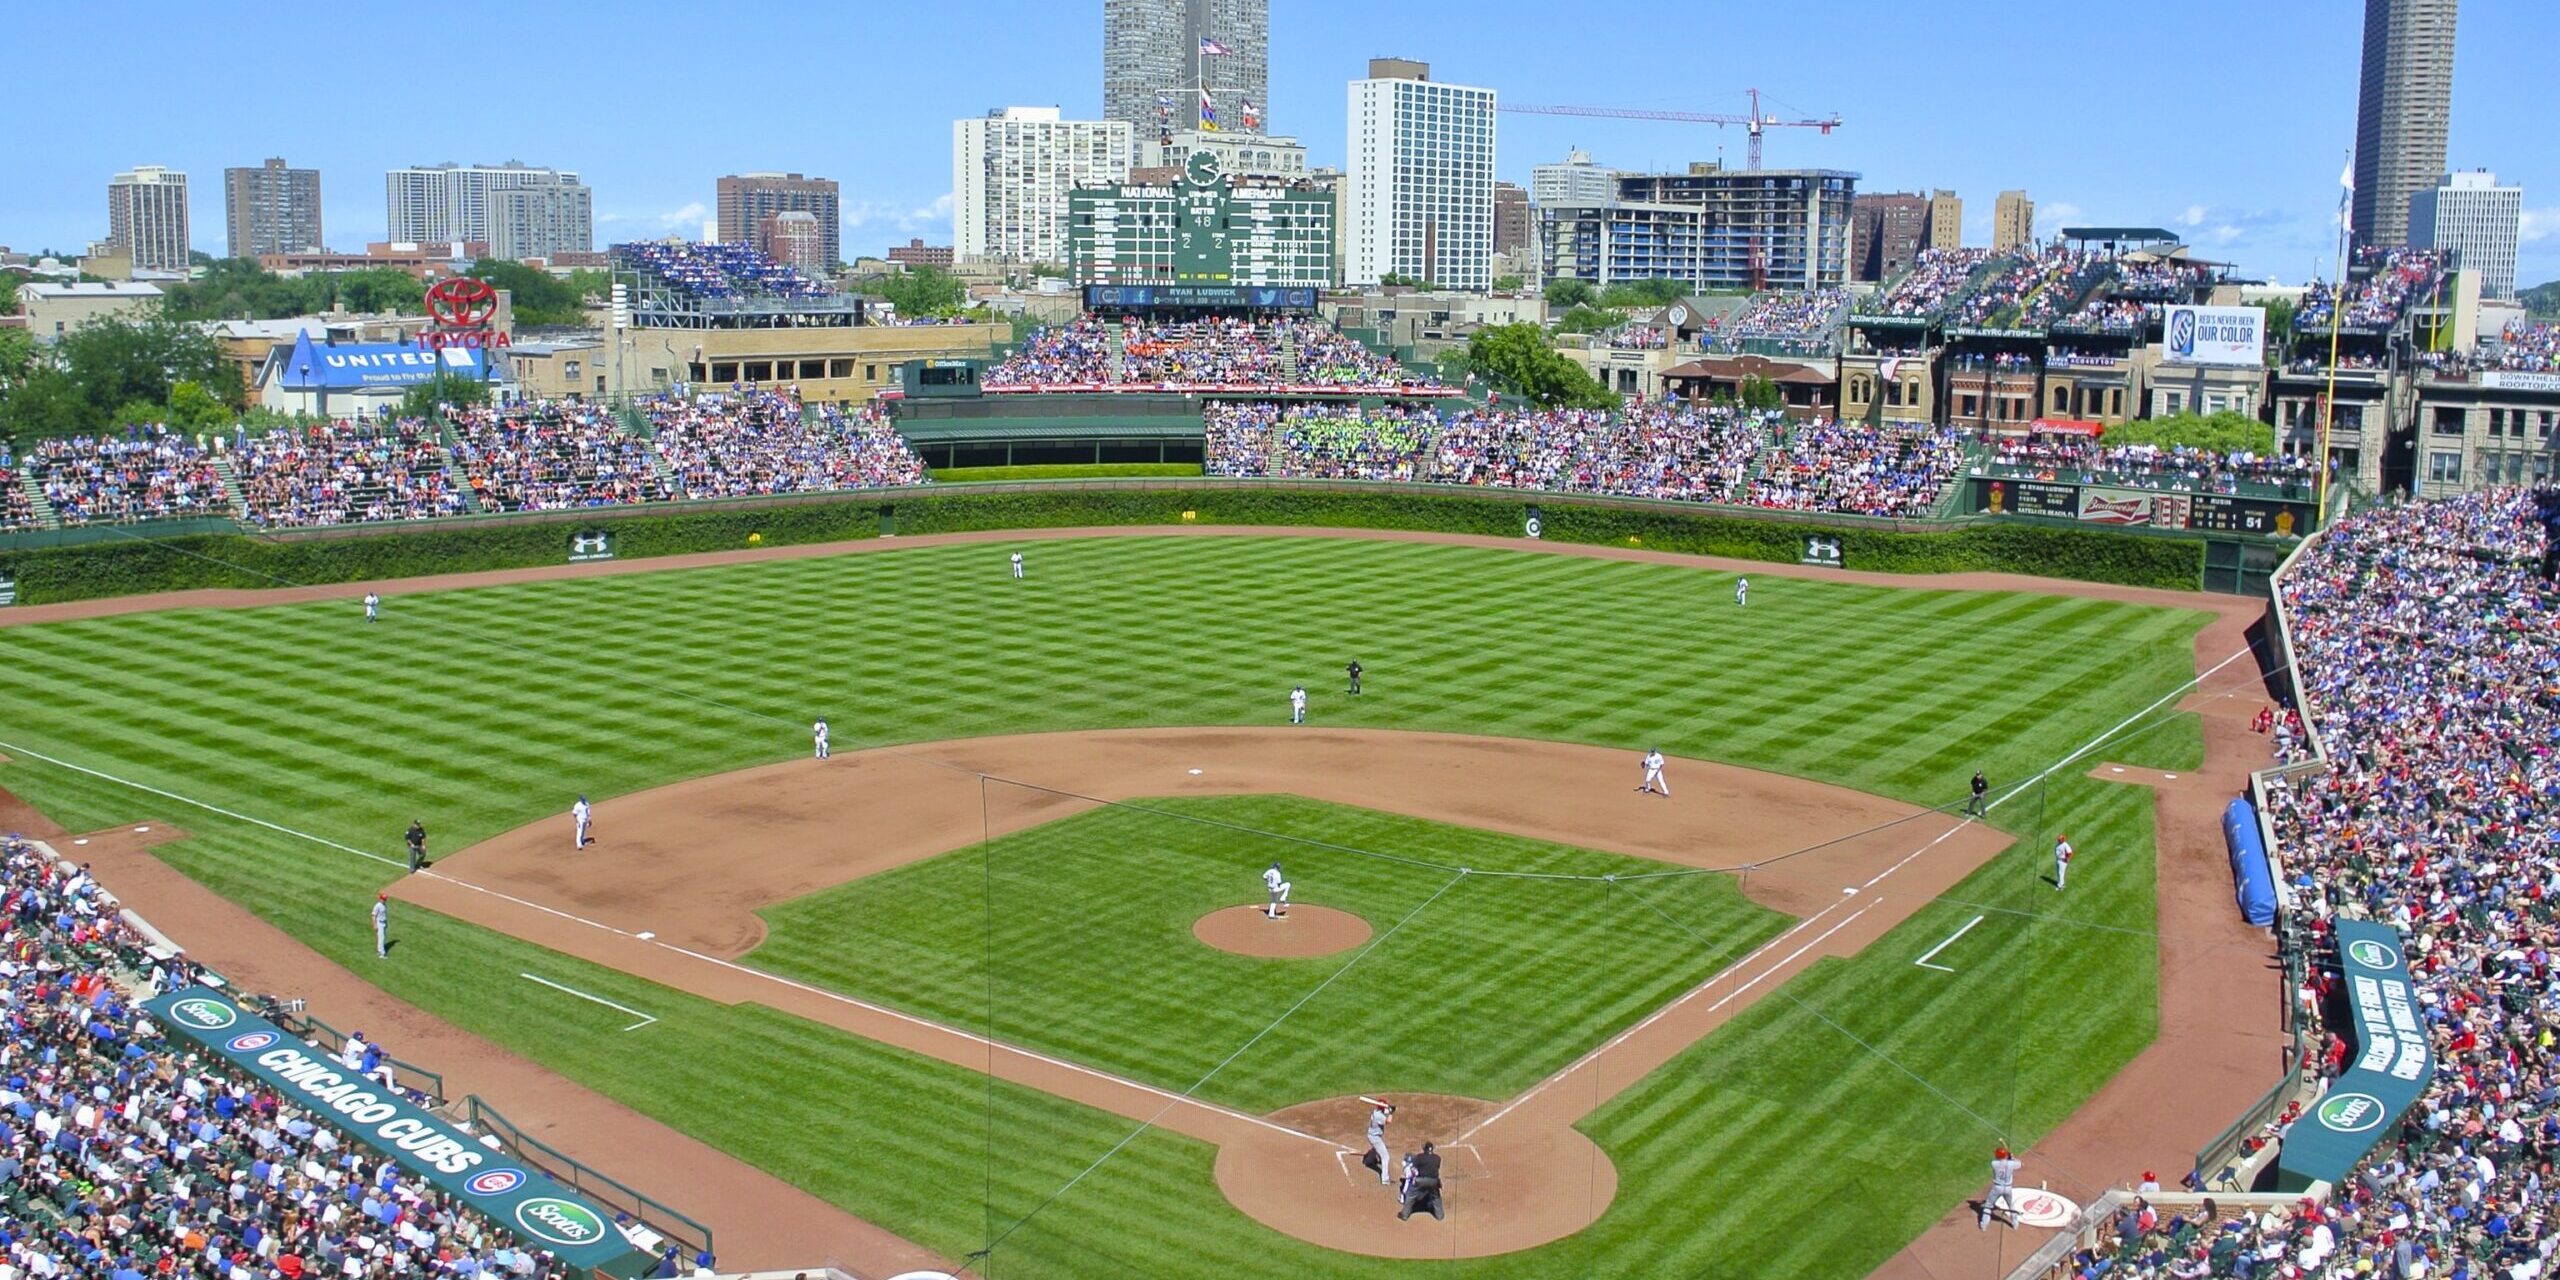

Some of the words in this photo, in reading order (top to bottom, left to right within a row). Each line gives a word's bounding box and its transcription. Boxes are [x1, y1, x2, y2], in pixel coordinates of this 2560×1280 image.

[1121, 187, 1176, 198] NATIONAL
[1231, 188, 1285, 199] AMERICAN
[1190, 207, 1216, 215] BATTER
[1194, 216, 1211, 228] 48
[1183, 238, 1191, 249] 2
[1215, 238, 1222, 249] 2
[2217, 315, 2237, 325] NEVER
[2239, 316, 2255, 326] BEEN
[415, 331, 512, 350] TOYOTA
[2198, 325, 2218, 342] OUR
[2221, 327, 2254, 343] COLOR
[326, 352, 436, 368] UNITED
[362, 374, 390, 382] Proud
[2032, 422, 2091, 435] Budweiser
[2091, 500, 2137, 513] Budweiser
[2246, 517, 2261, 529] 51
[182, 1002, 225, 1026] Scotts
[2361, 1006, 2388, 1024] THE
[2365, 1022, 2393, 1035] TO
[2395, 1029, 2424, 1044] OF
[2358, 1033, 2396, 1073] WELCOME
[258, 1048, 397, 1124] CHICAGO
[2329, 1097, 2372, 1128] Scotts
[377, 1118, 483, 1174] CUBS
[527, 1204, 591, 1240] Scotts
